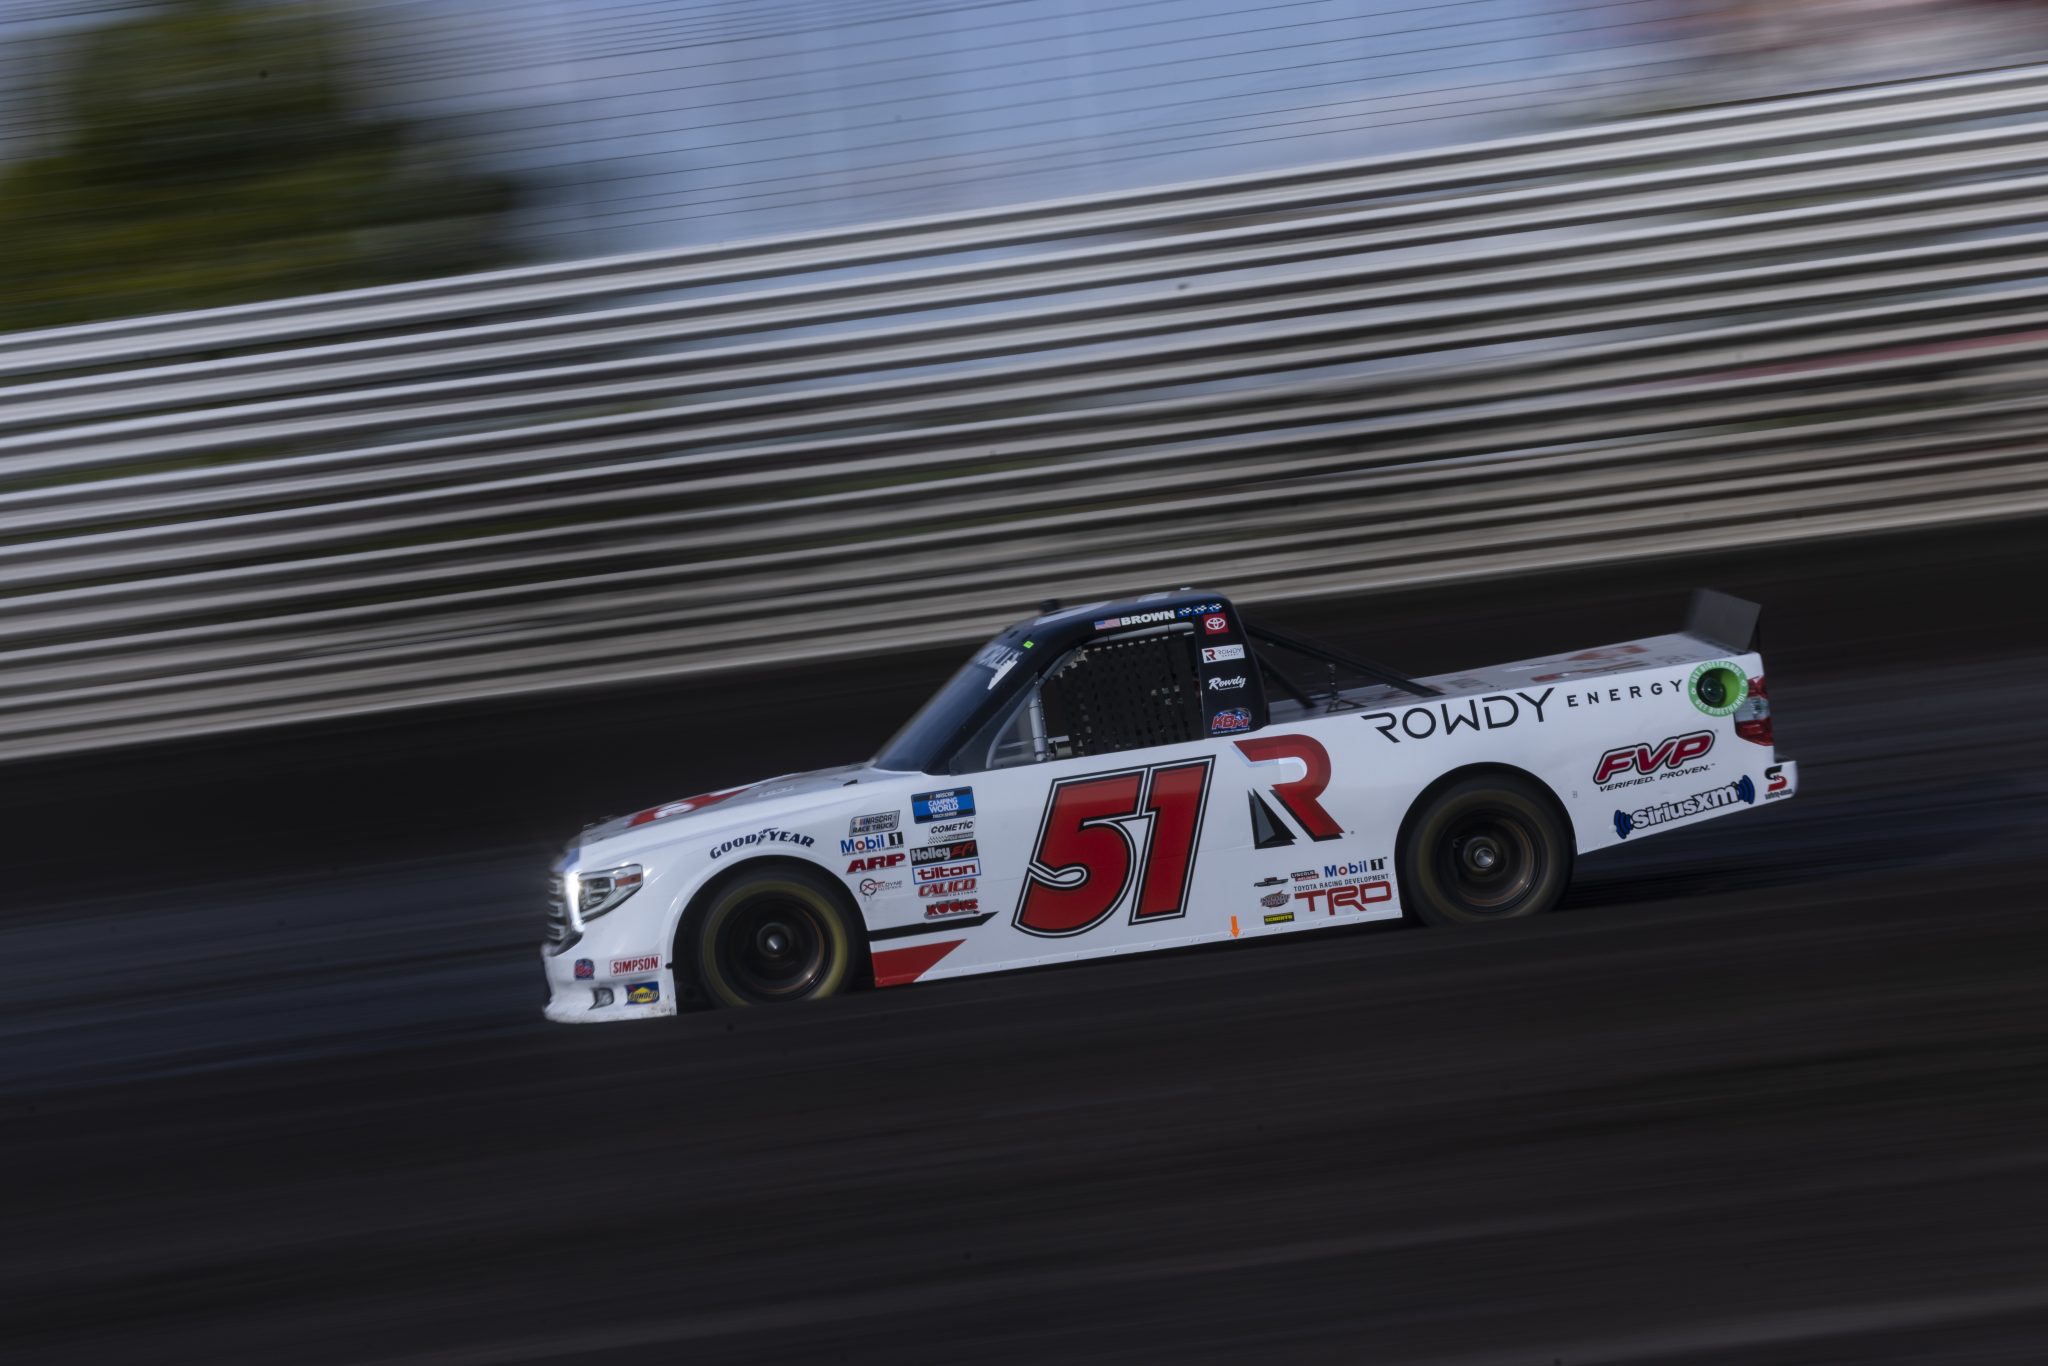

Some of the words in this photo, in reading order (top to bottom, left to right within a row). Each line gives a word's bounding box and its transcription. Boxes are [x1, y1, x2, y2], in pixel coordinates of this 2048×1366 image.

[1120, 609, 1176, 626] BROWN
[1217, 647, 1242, 656] ROWDY
[1208, 675, 1247, 691] Rowdy
[1360, 687, 1555, 744] ROWDY
[1566, 679, 1683, 707] ENERGY
[1211, 713, 1250, 731] KBM
[1592, 729, 1716, 785] FVP
[1599, 776, 1655, 792] VERIFIED.
[1659, 765, 1711, 781] PROVEN.
[928, 796, 958, 807] CAMPING
[935, 791, 955, 799] NASCAR
[928, 803, 959, 814] WORLD
[852, 825, 870, 833] RACE
[872, 821, 895, 831] TRUCK
[866, 814, 893, 825] NASCAR
[930, 821, 974, 834] COMETIC
[840, 834, 885, 854] Mobil
[888, 832, 904, 847] 1
[1010, 754, 1217, 939] 51
[910, 846, 951, 862] Holley
[846, 852, 906, 875] ARP
[917, 864, 977, 881] tilton
[1324, 860, 1368, 878] Mobil
[1370, 858, 1384, 871] 1
[918, 878, 977, 897] CALICO
[1293, 883, 1317, 892] TOYOTA
[1319, 880, 1343, 889] RACING
[1344, 873, 1390, 885] DEVELOPMENT
[926, 898, 978, 916] KOOKS
[1294, 880, 1392, 916] TRD
[613, 956, 659, 974] SIMPSON
[629, 991, 659, 1001] SUNOCO
